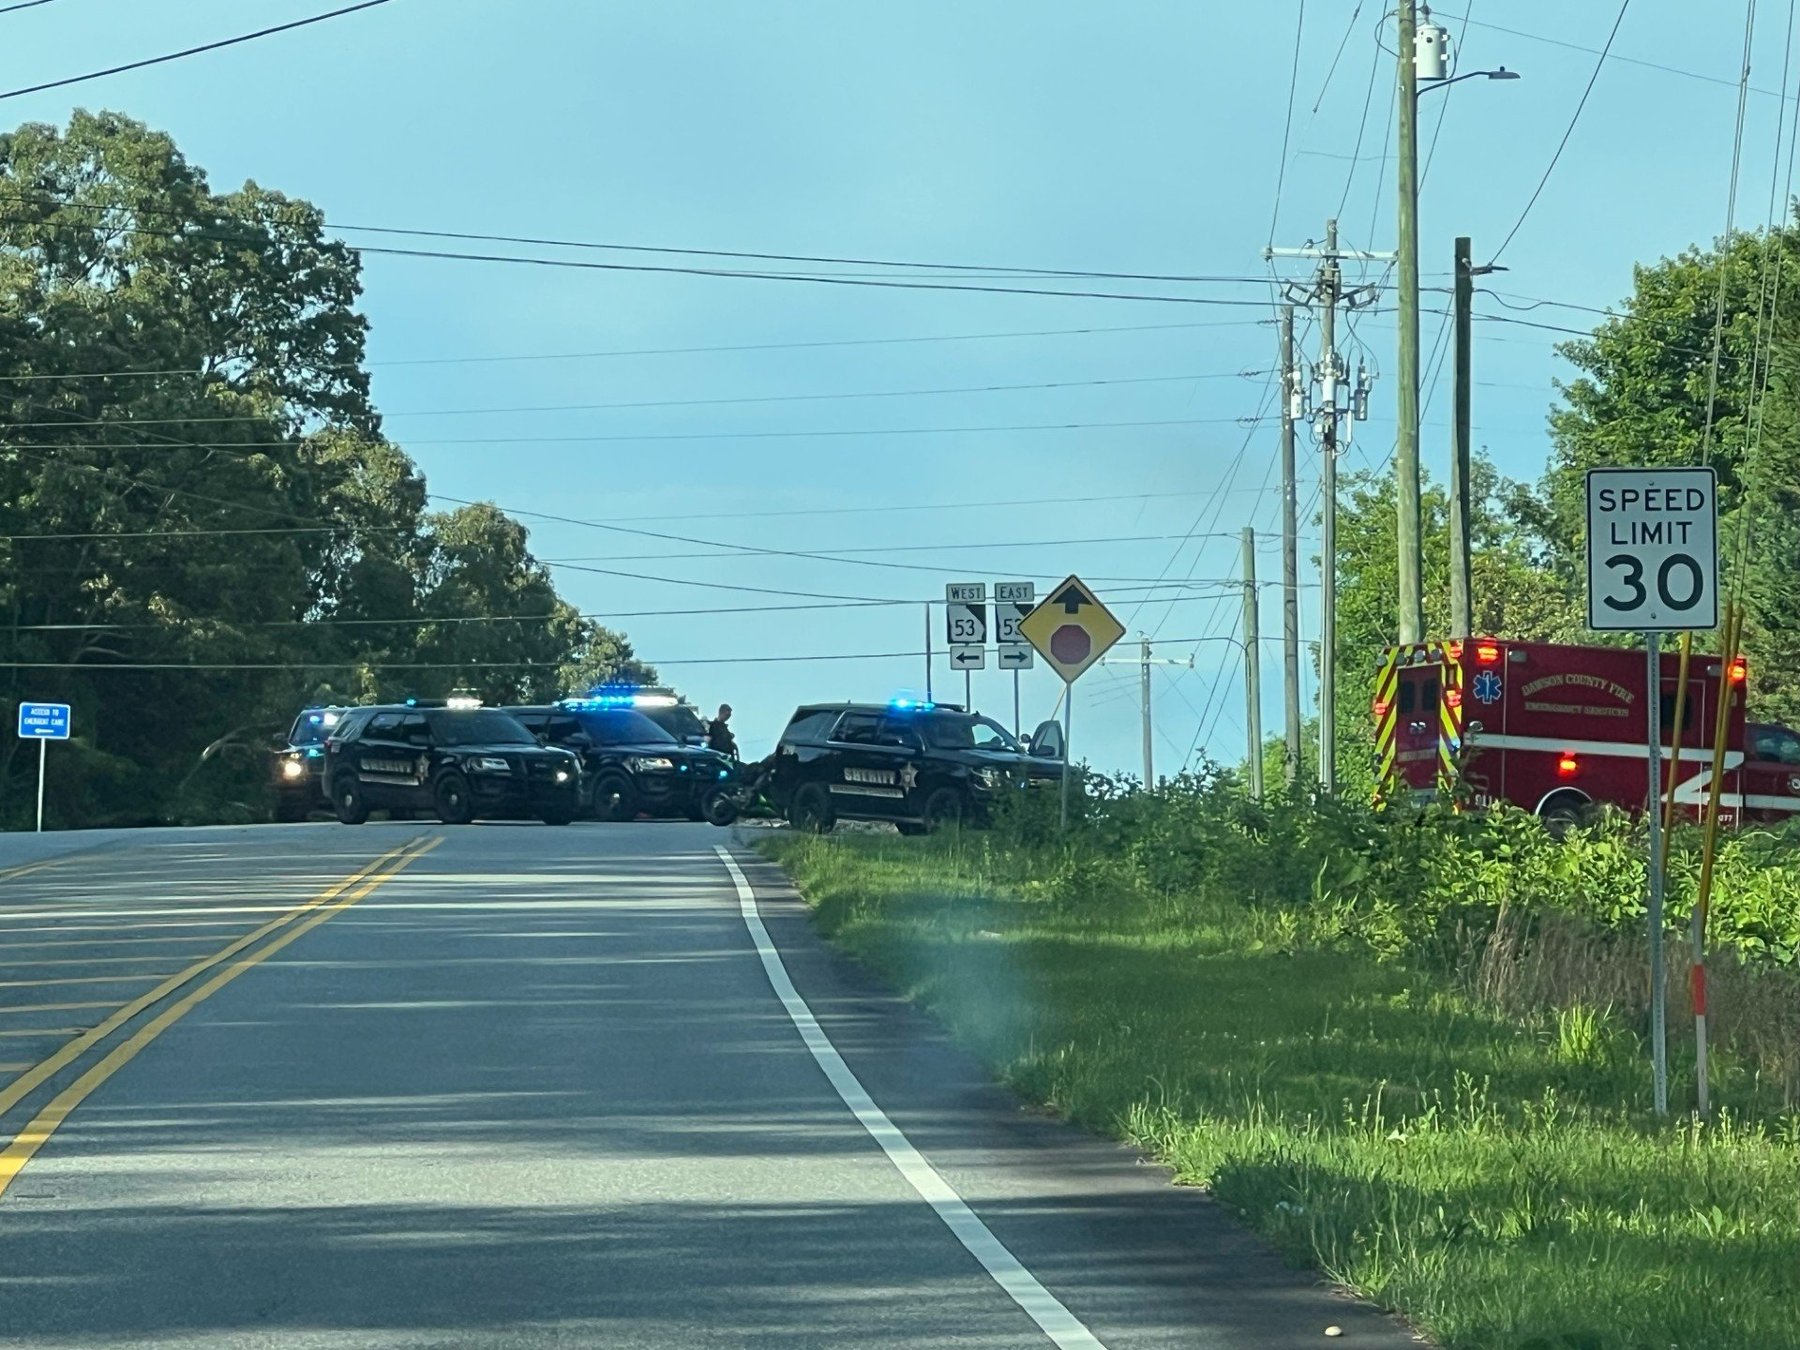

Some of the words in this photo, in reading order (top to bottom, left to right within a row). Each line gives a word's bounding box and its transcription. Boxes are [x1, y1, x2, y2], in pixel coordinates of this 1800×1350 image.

[1599, 488, 1705, 512] SPEED
[1611, 521, 1692, 545] LIMIT
[951, 587, 980, 599] WEST
[1000, 586, 1028, 599] EAST
[1603, 553, 1704, 612] 30
[955, 619, 975, 636] 53
[1565, 674, 1608, 690] COUNTY
[1608, 682, 1635, 704] FIRE
[843, 767, 895, 785] SHERIFF
